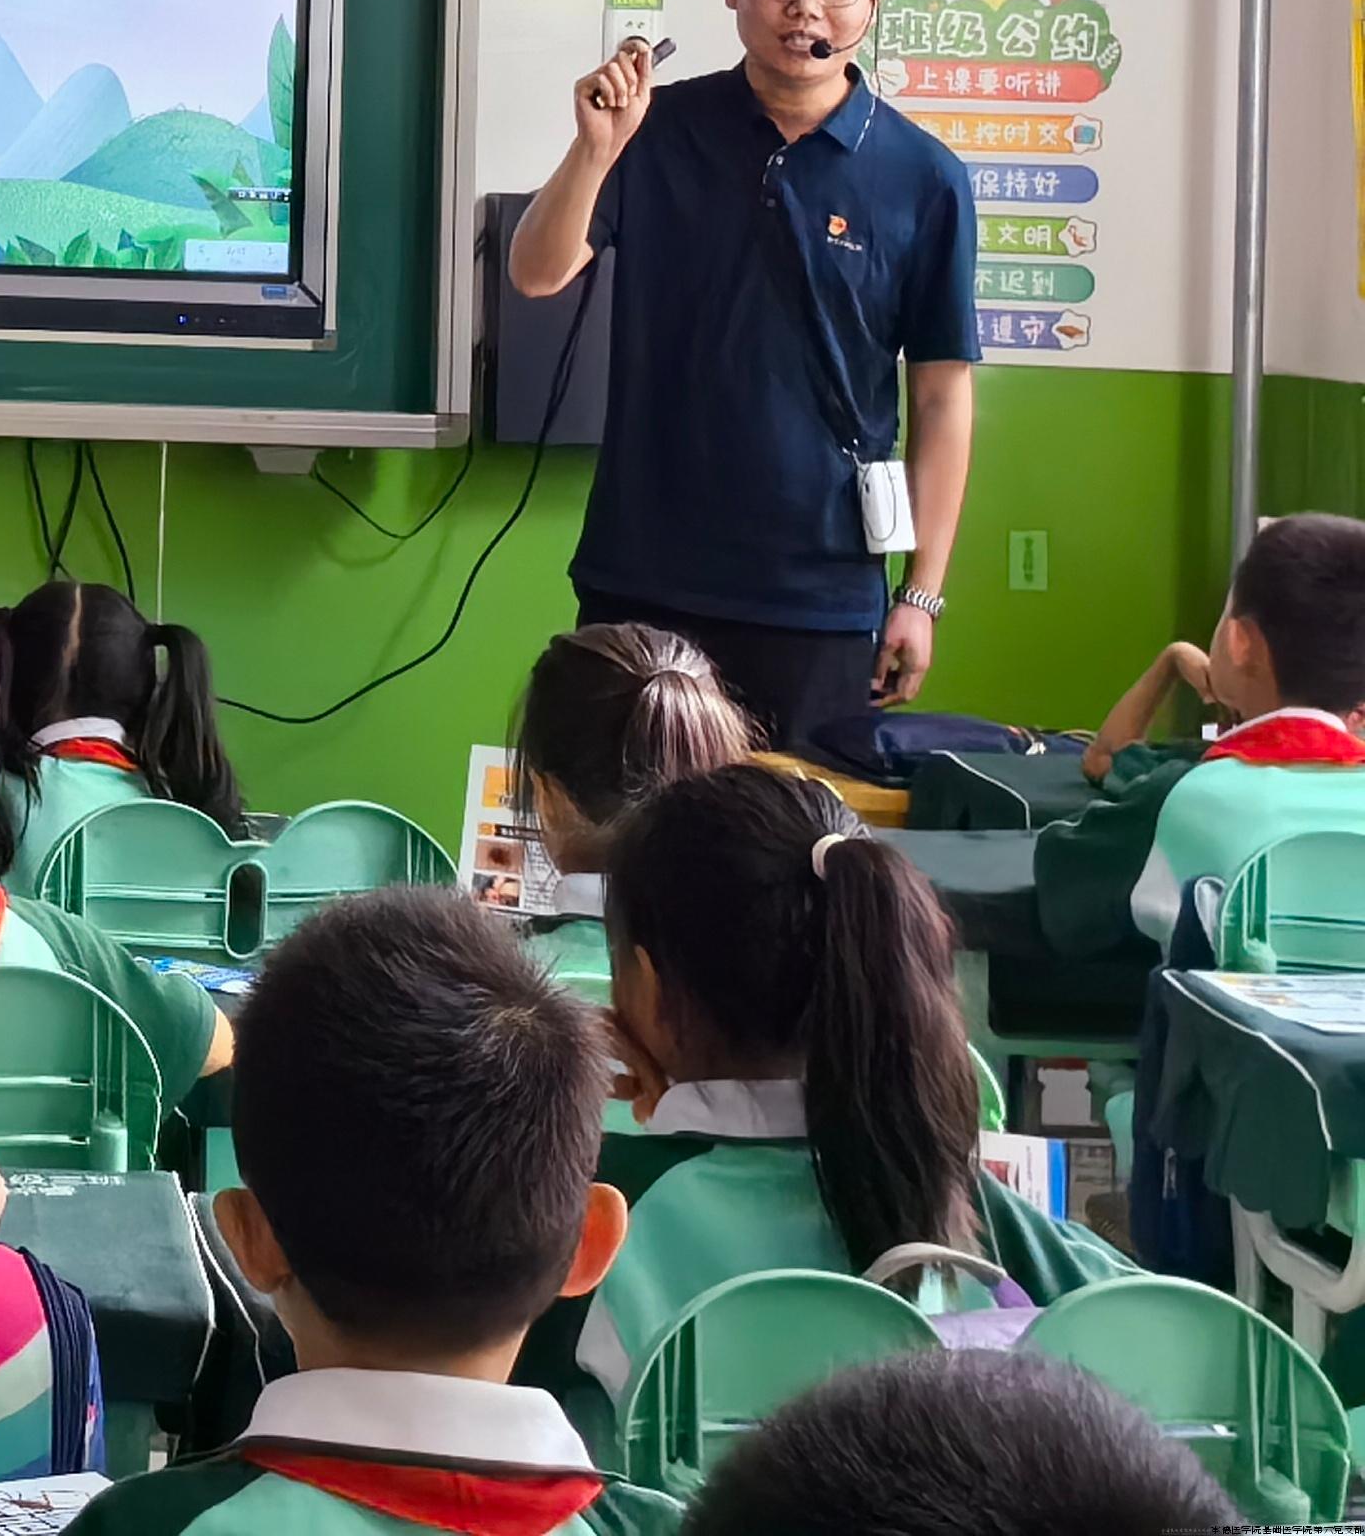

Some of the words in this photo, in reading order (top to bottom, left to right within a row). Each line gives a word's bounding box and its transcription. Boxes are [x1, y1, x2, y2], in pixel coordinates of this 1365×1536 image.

[879, 8, 1099, 62] 班级公约
[916, 65, 1062, 98] 上课要听讲
[971, 168, 1060, 198] 保持好
[979, 314, 1046, 346] 遵守
